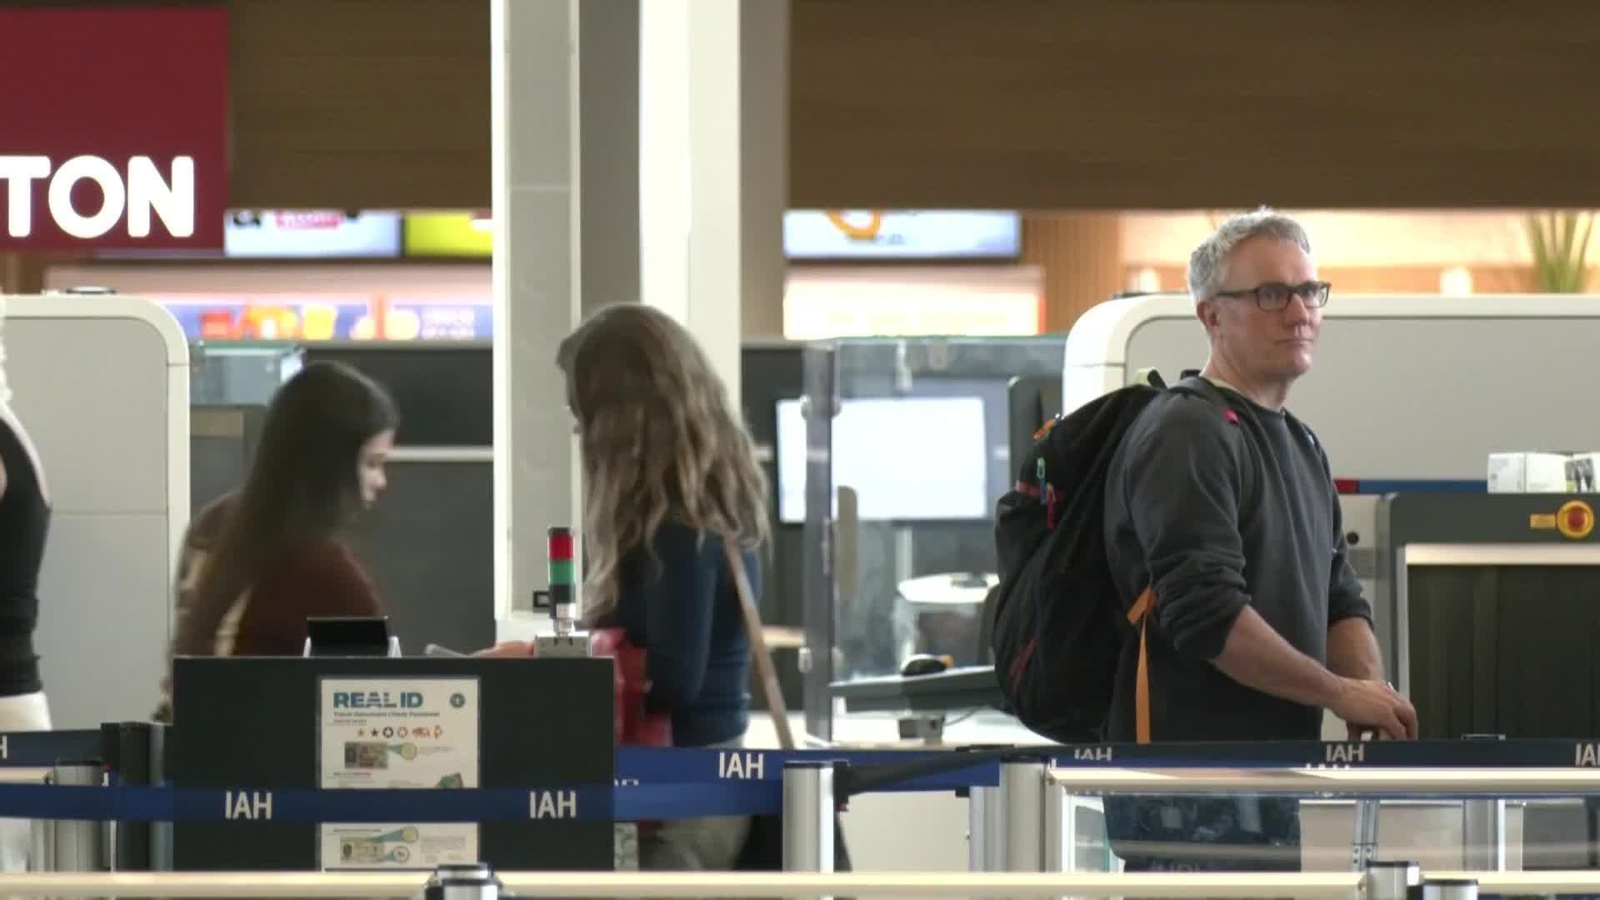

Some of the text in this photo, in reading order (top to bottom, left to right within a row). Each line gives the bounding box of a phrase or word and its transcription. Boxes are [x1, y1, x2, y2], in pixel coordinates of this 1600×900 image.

[0, 155, 195, 238] TON
[333, 692, 424, 708] REAL ID
[718, 752, 764, 780] IAH
[1326, 744, 1365, 762] IAH
[1575, 743, 1600, 767] IA
[225, 791, 273, 821] IAH
[529, 791, 577, 820] IAH
